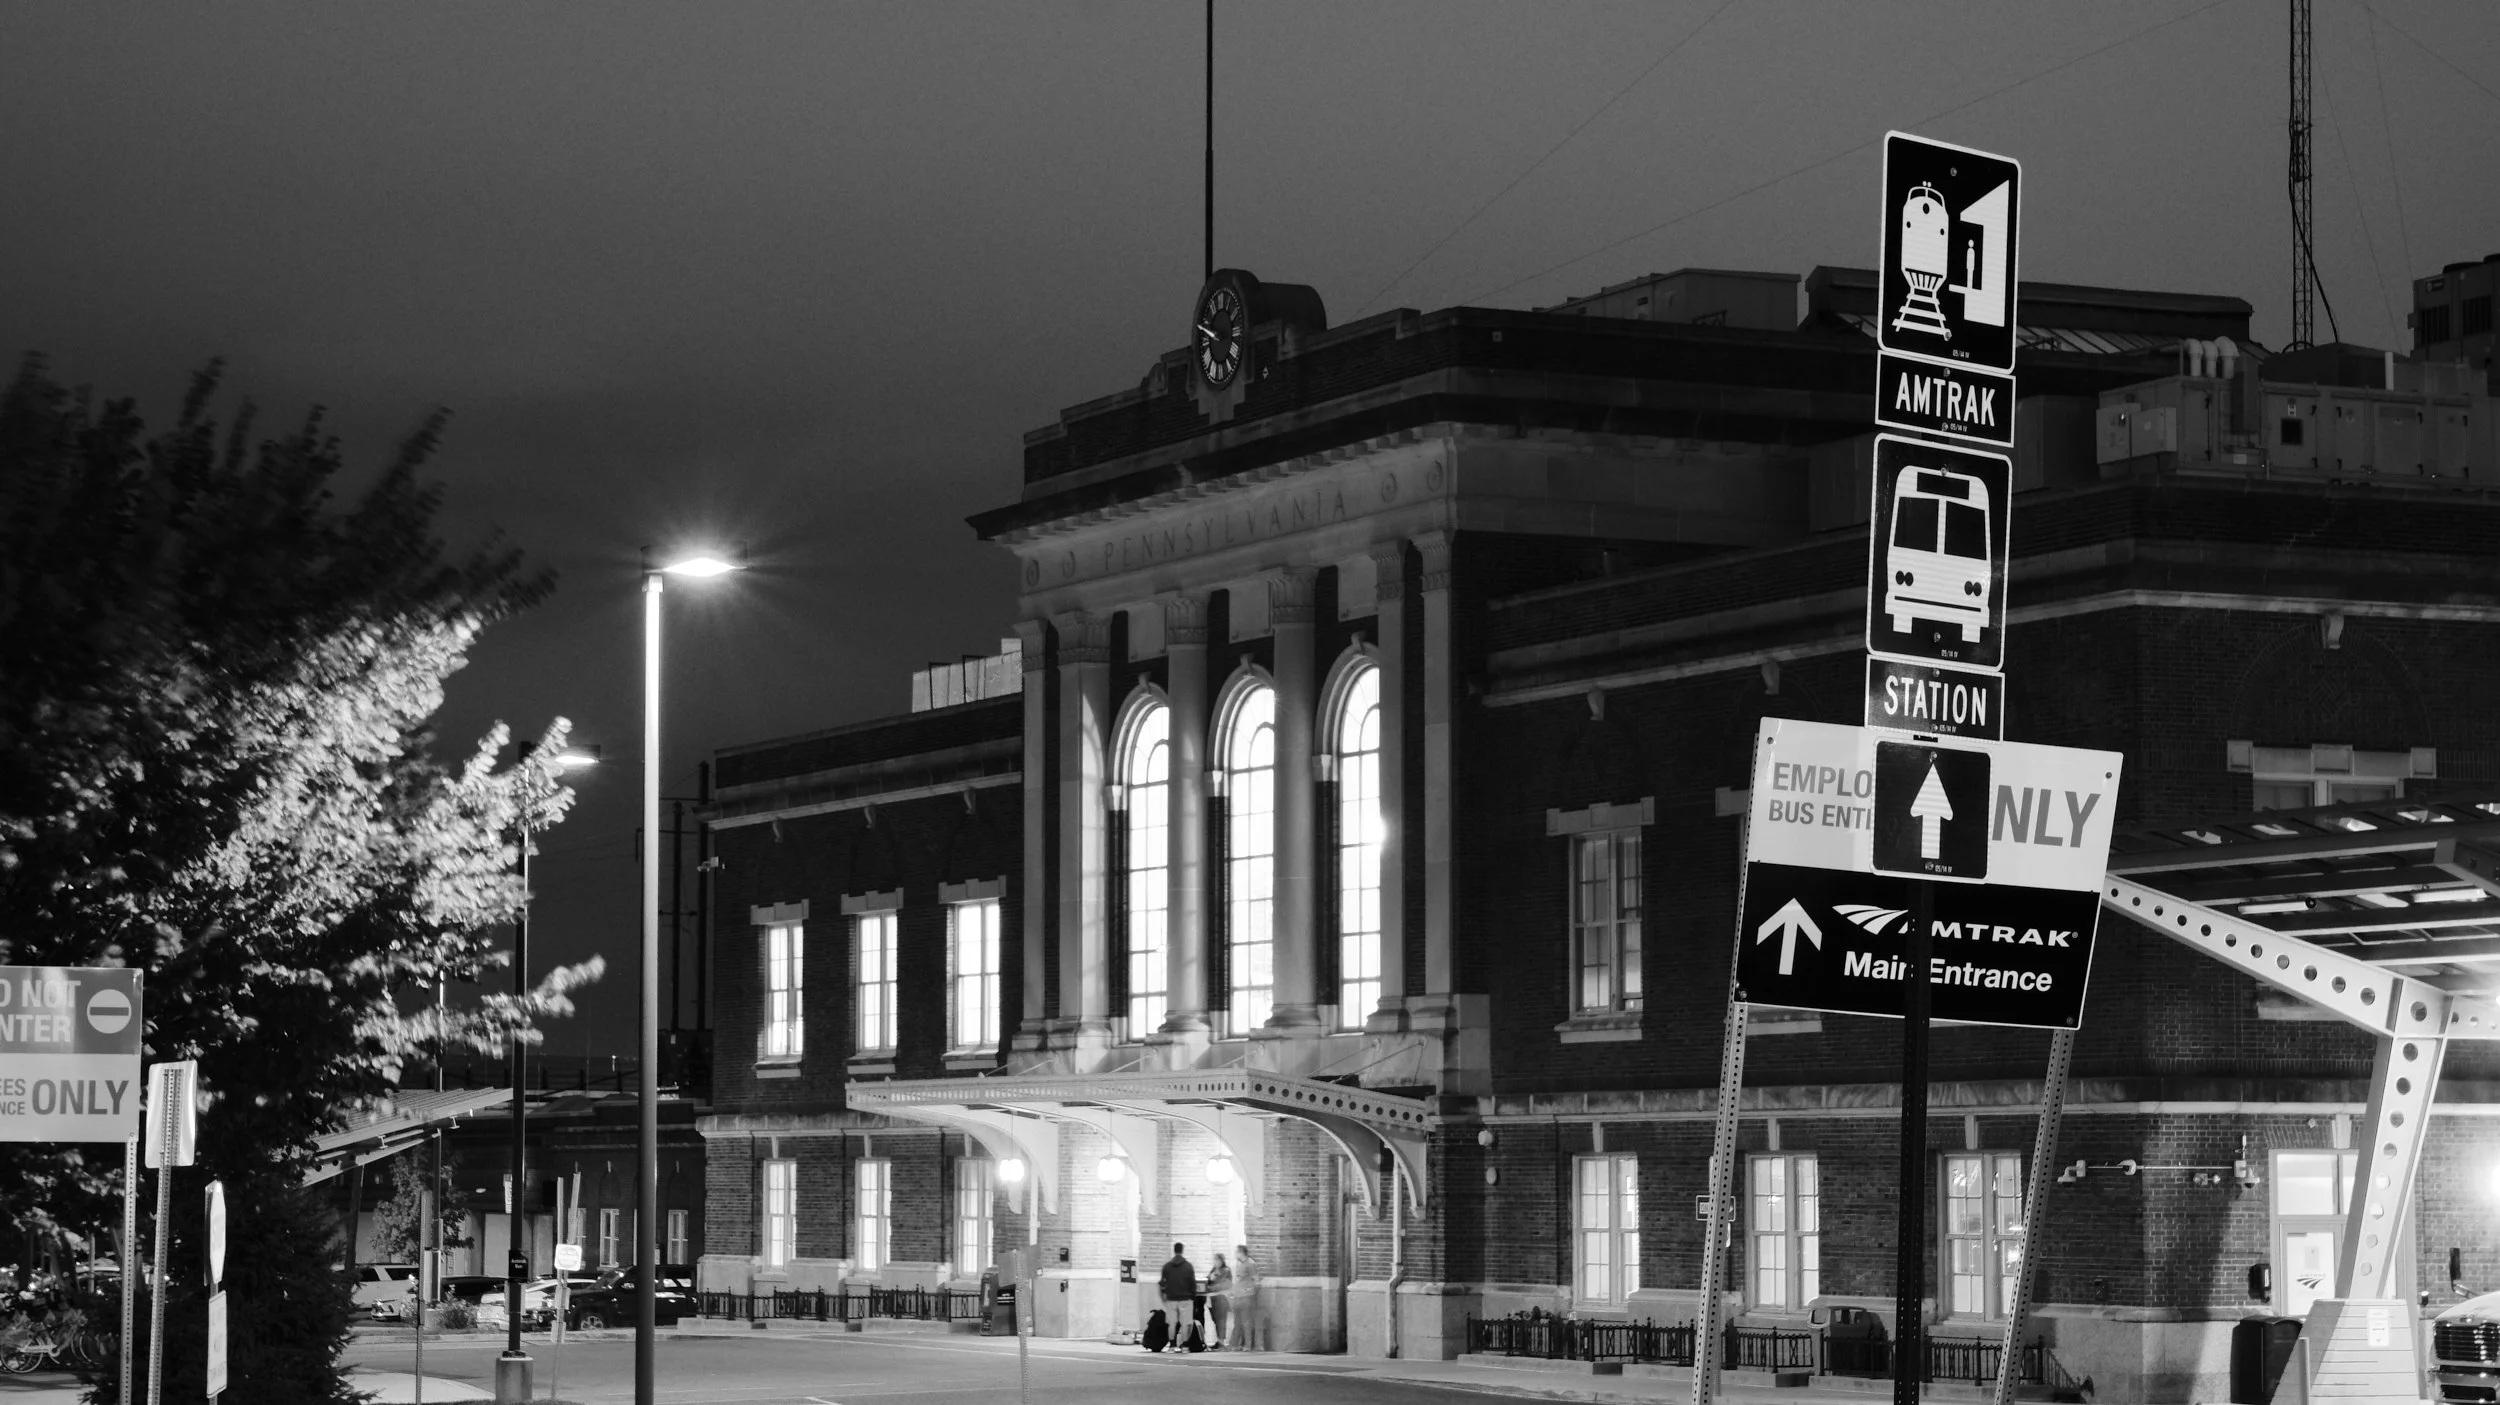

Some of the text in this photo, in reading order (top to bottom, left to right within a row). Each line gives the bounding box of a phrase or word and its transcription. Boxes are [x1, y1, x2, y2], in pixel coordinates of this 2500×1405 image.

[1895, 371, 1996, 427] AMTRAK
[1104, 487, 1347, 572] PENNSYLVANIA
[1884, 675, 1987, 727] STATION
[1773, 762, 1872, 799] EMPLO
[1768, 798, 1872, 830] BUS ENT
[1992, 784, 2102, 848] NLY
[1930, 957, 2053, 991] Entrance
[0, 978, 82, 1008] O NOT
[0, 1013, 71, 1042] NTER
[32, 1078, 129, 1115] ONLY
